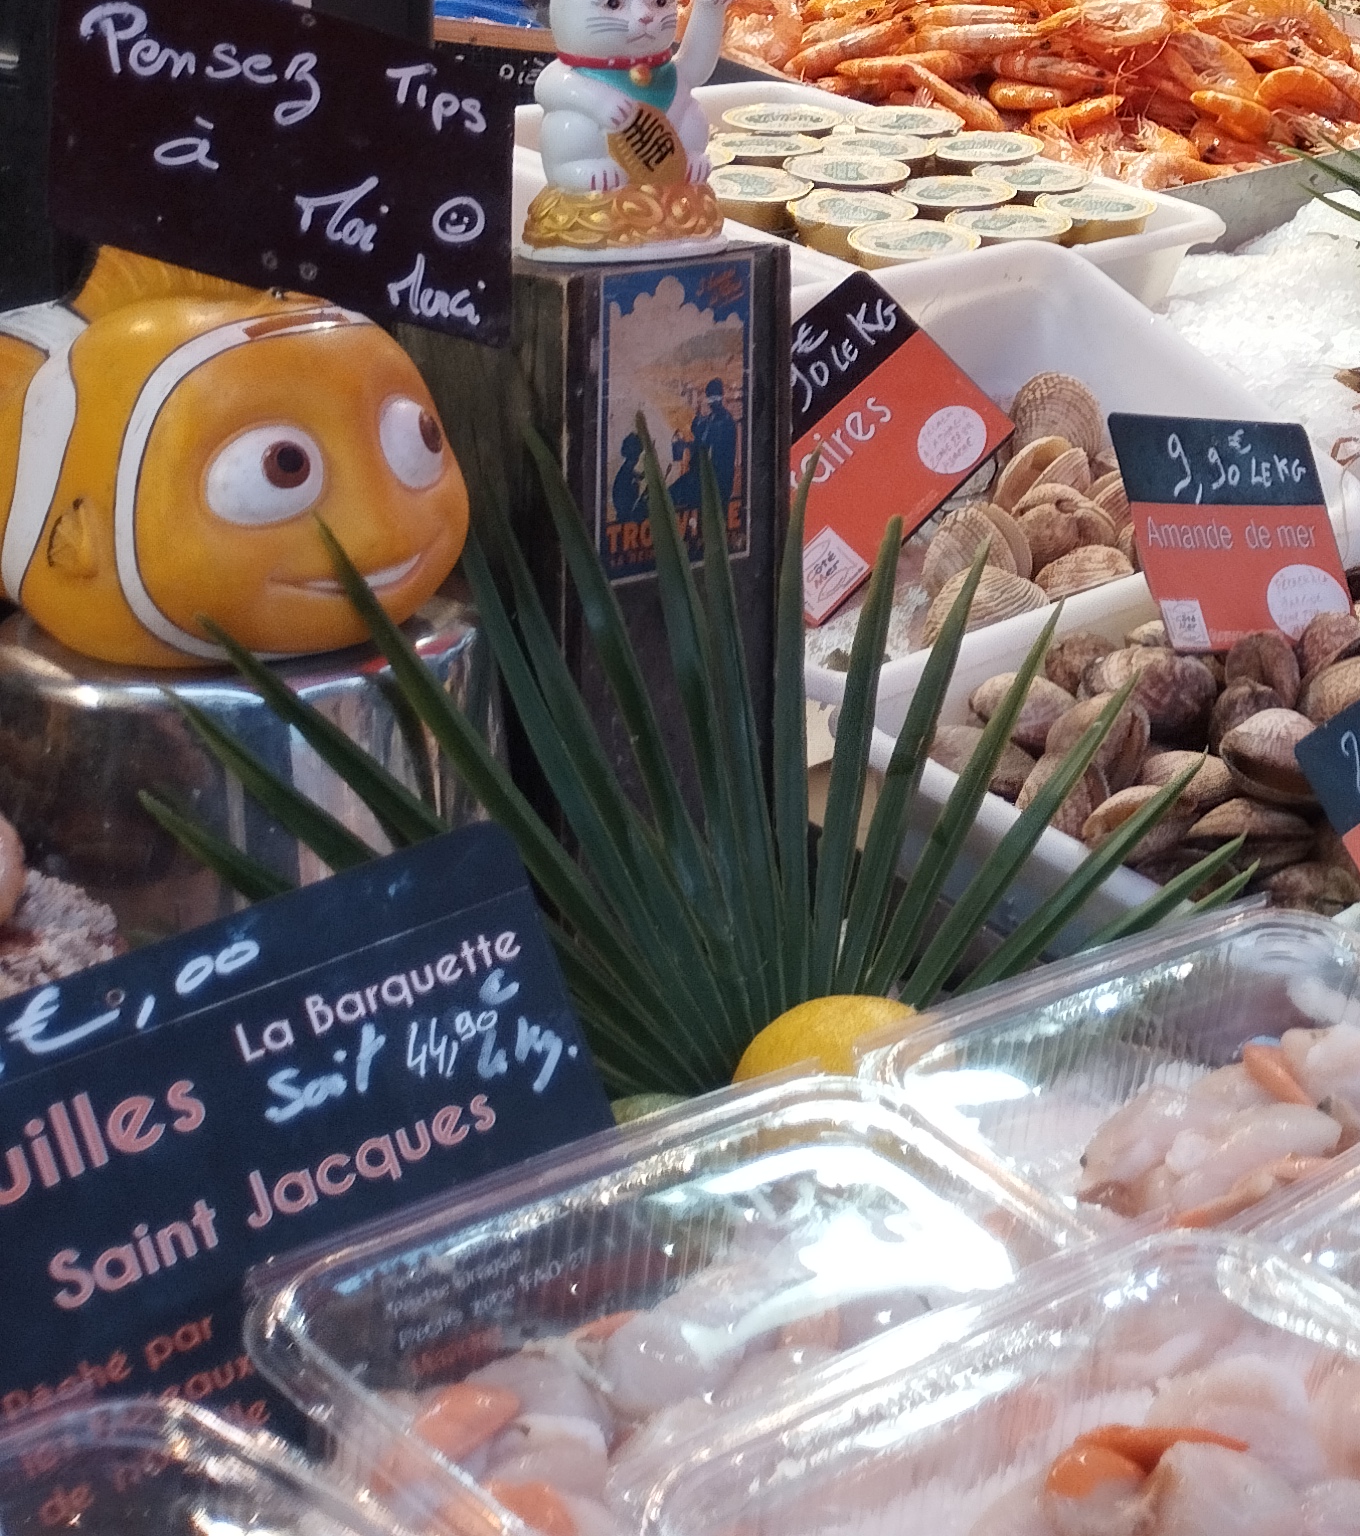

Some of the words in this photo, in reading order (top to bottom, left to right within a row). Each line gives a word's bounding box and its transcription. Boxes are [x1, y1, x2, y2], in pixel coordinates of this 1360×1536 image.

[80, 1, 320, 127] Pensez
[386, 63, 488, 133] Tips
[154, 116, 220, 170] à
[295, 176, 390, 253] Moi
[386, 253, 487, 327] Merci
[847, 298, 898, 345] KG
[831, 337, 859, 372] LE
[1251, 456, 1273, 487] LE
[1273, 454, 1307, 483] KG
[1147, 516, 1234, 550] Amande
[1244, 518, 1272, 550] de
[1277, 526, 1316, 548] mer
[233, 1018, 296, 1064] La
[304, 929, 522, 1037] Barquette
[264, 1019, 388, 1125] Soit
[48, 1198, 221, 1312] Saint
[246, 1093, 498, 1230] Jacques
[144, 1313, 214, 1372] par
